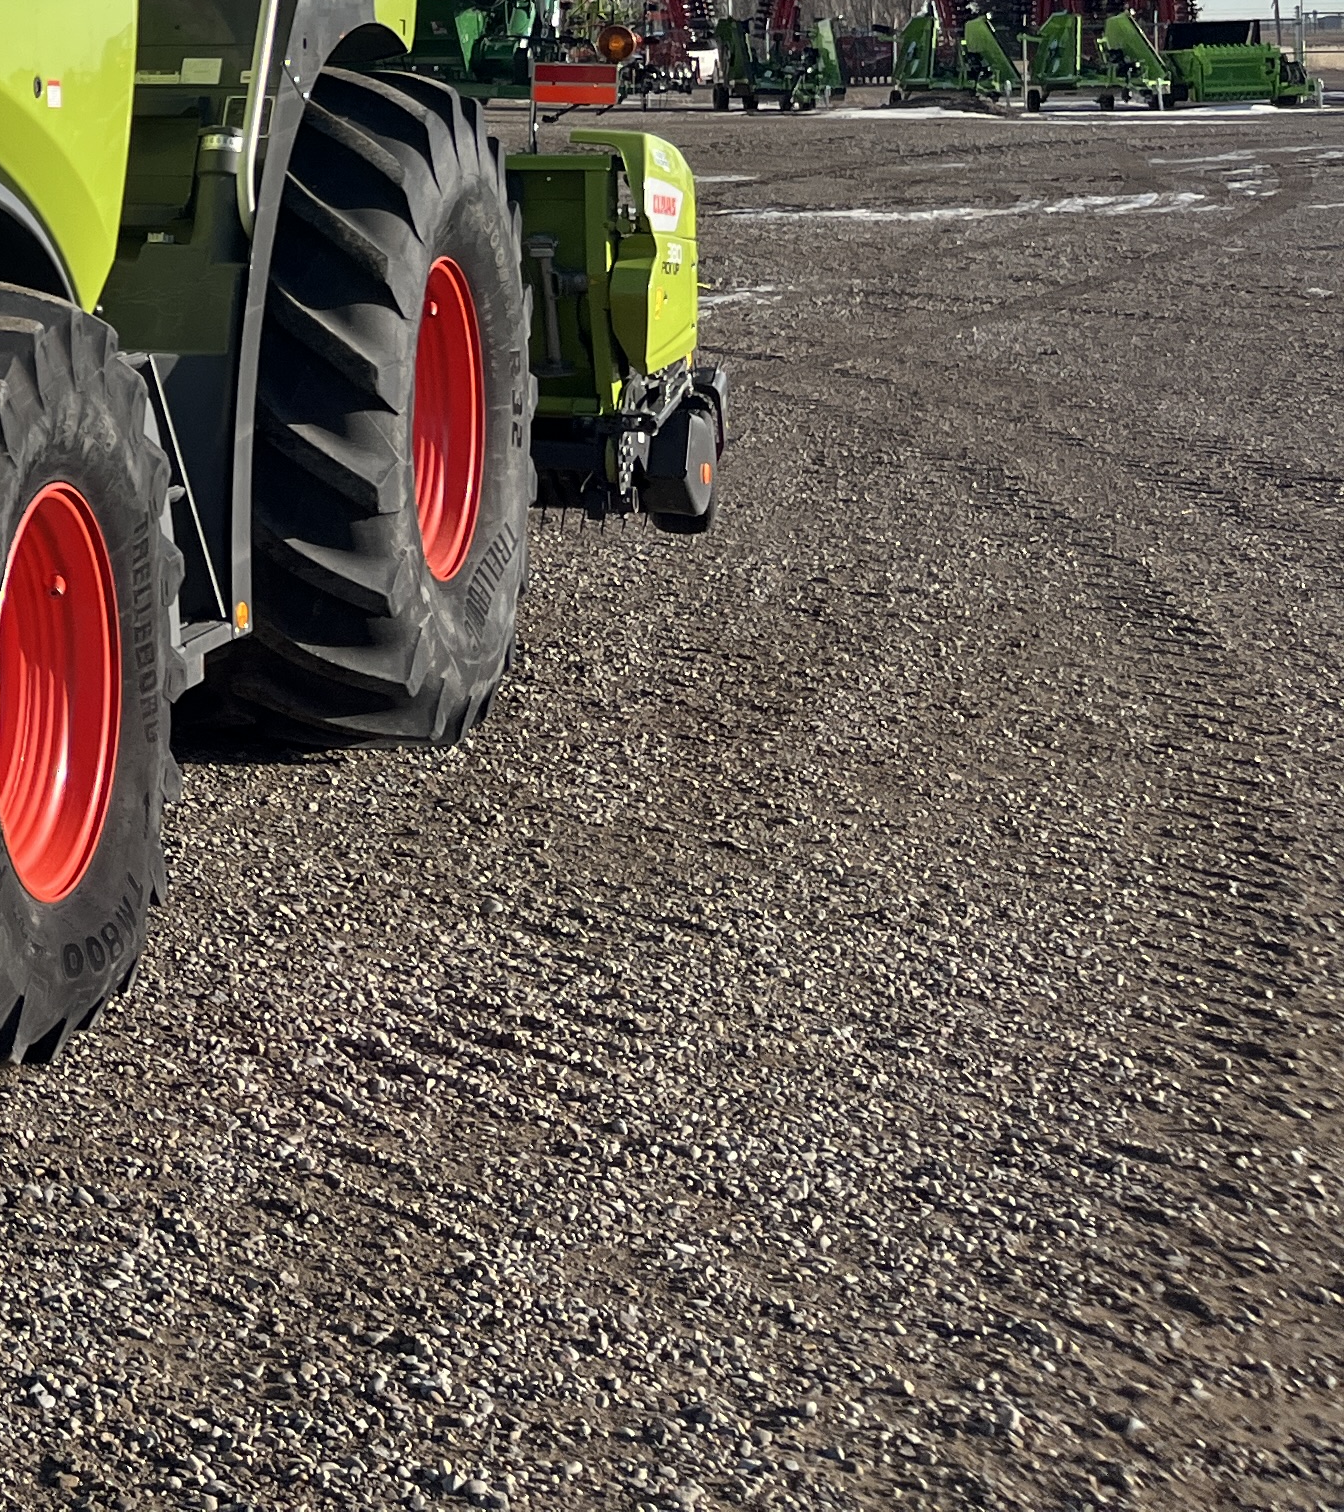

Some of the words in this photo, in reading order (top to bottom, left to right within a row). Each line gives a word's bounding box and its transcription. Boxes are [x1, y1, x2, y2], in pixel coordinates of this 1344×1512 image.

[653, 195, 676, 216] CLAAS
[132, 512, 160, 743] TRELLEBORG
[62, 871, 143, 979] TM800
